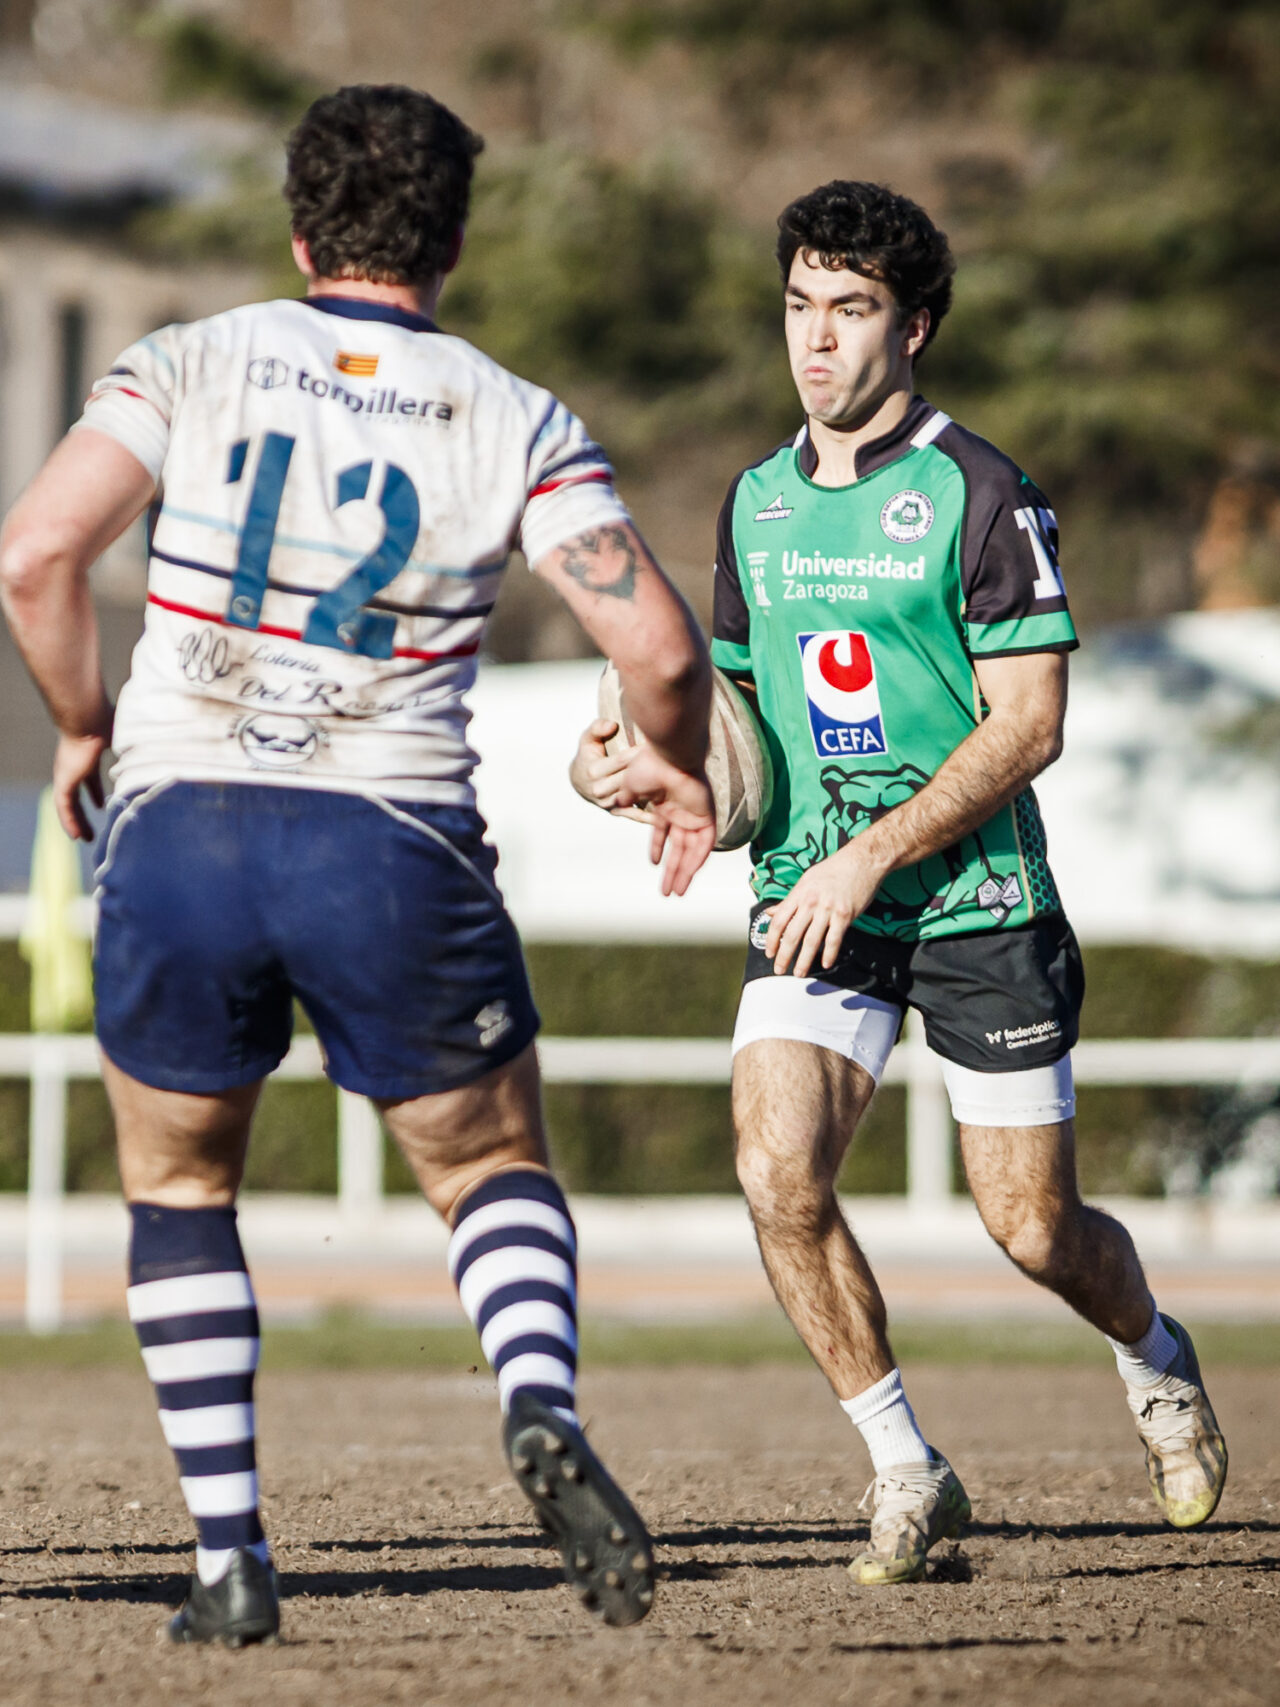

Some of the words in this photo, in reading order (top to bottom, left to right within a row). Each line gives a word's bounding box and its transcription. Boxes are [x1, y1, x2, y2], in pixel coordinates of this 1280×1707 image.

[297, 368, 453, 421] tornillera
[226, 430, 420, 660] 12
[782, 550, 925, 580] Universidad
[782, 579, 869, 604] Zaragoza
[238, 675, 290, 701] Del
[820, 727, 882, 752] CEFA
